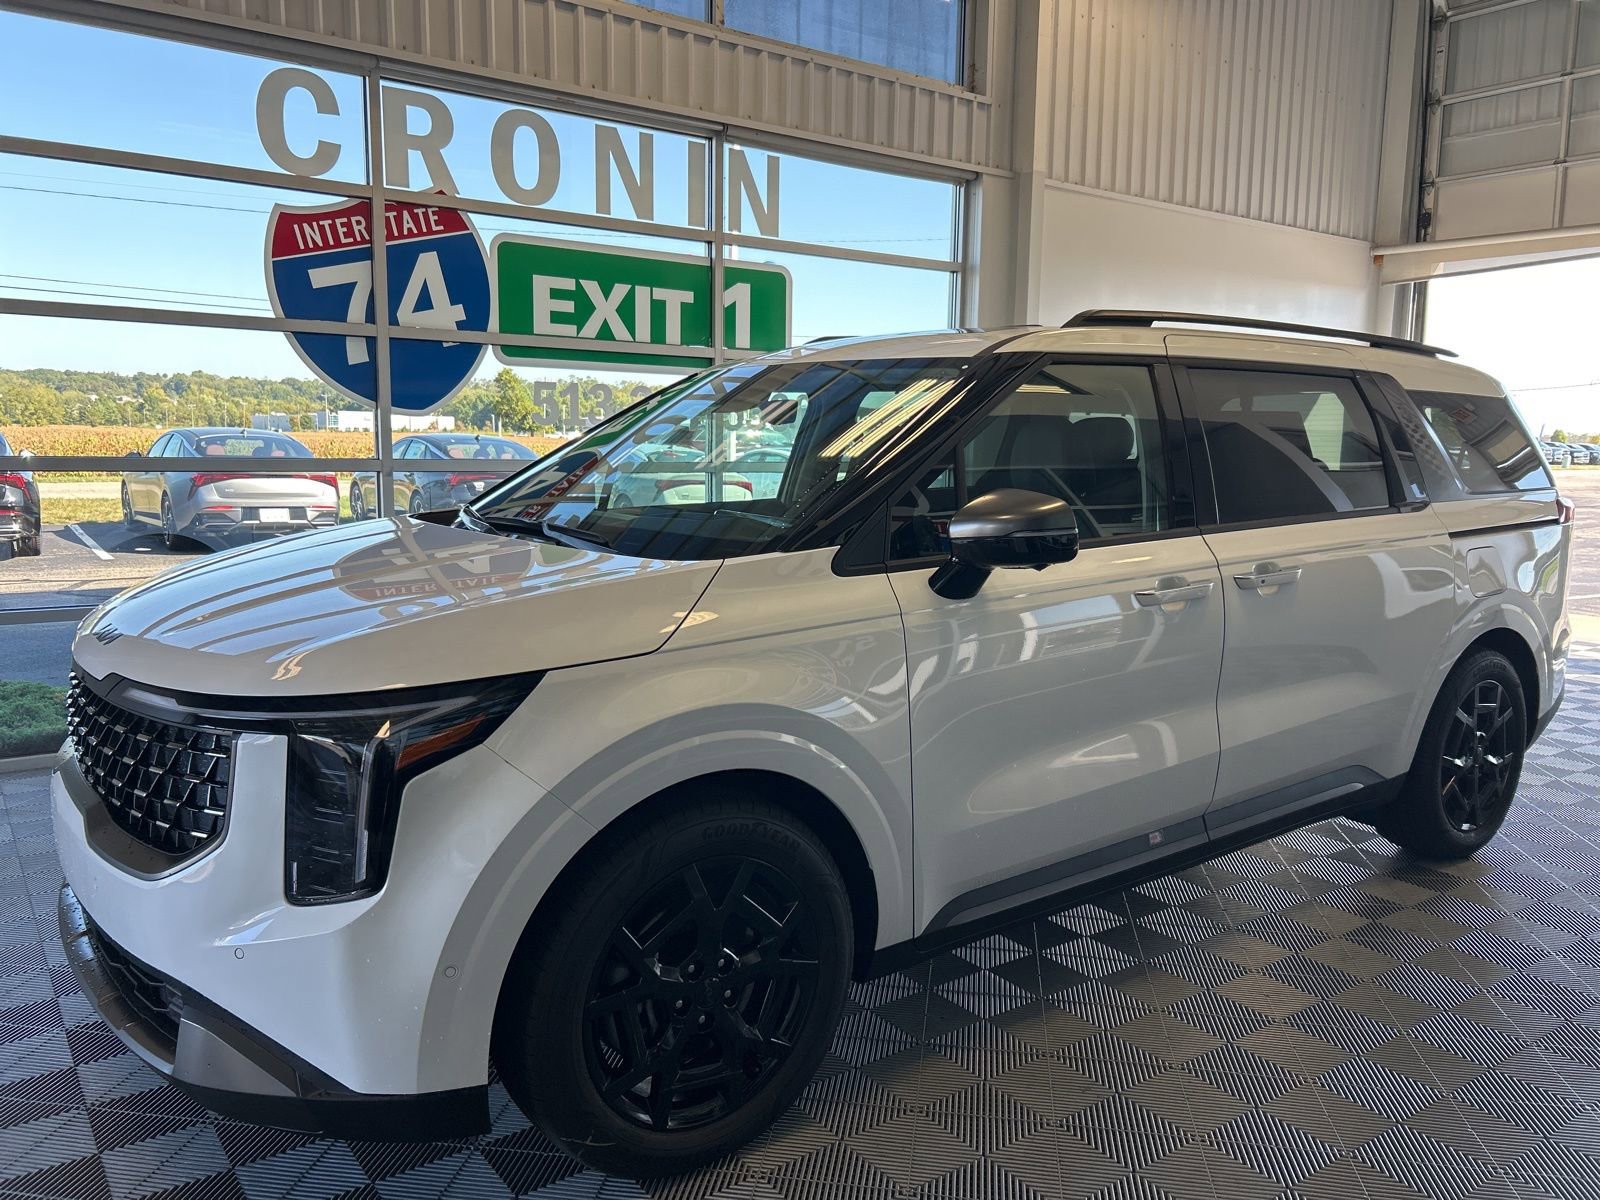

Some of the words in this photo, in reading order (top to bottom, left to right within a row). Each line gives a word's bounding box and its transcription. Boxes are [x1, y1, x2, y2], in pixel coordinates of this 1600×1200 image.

[256, 67, 780, 237] CRONIN
[293, 207, 444, 249] INTERTATE
[308, 251, 467, 365] 74
[532, 274, 694, 346] EXIT
[722, 282, 751, 348] 1
[702, 822, 800, 848] GOODYEAR
